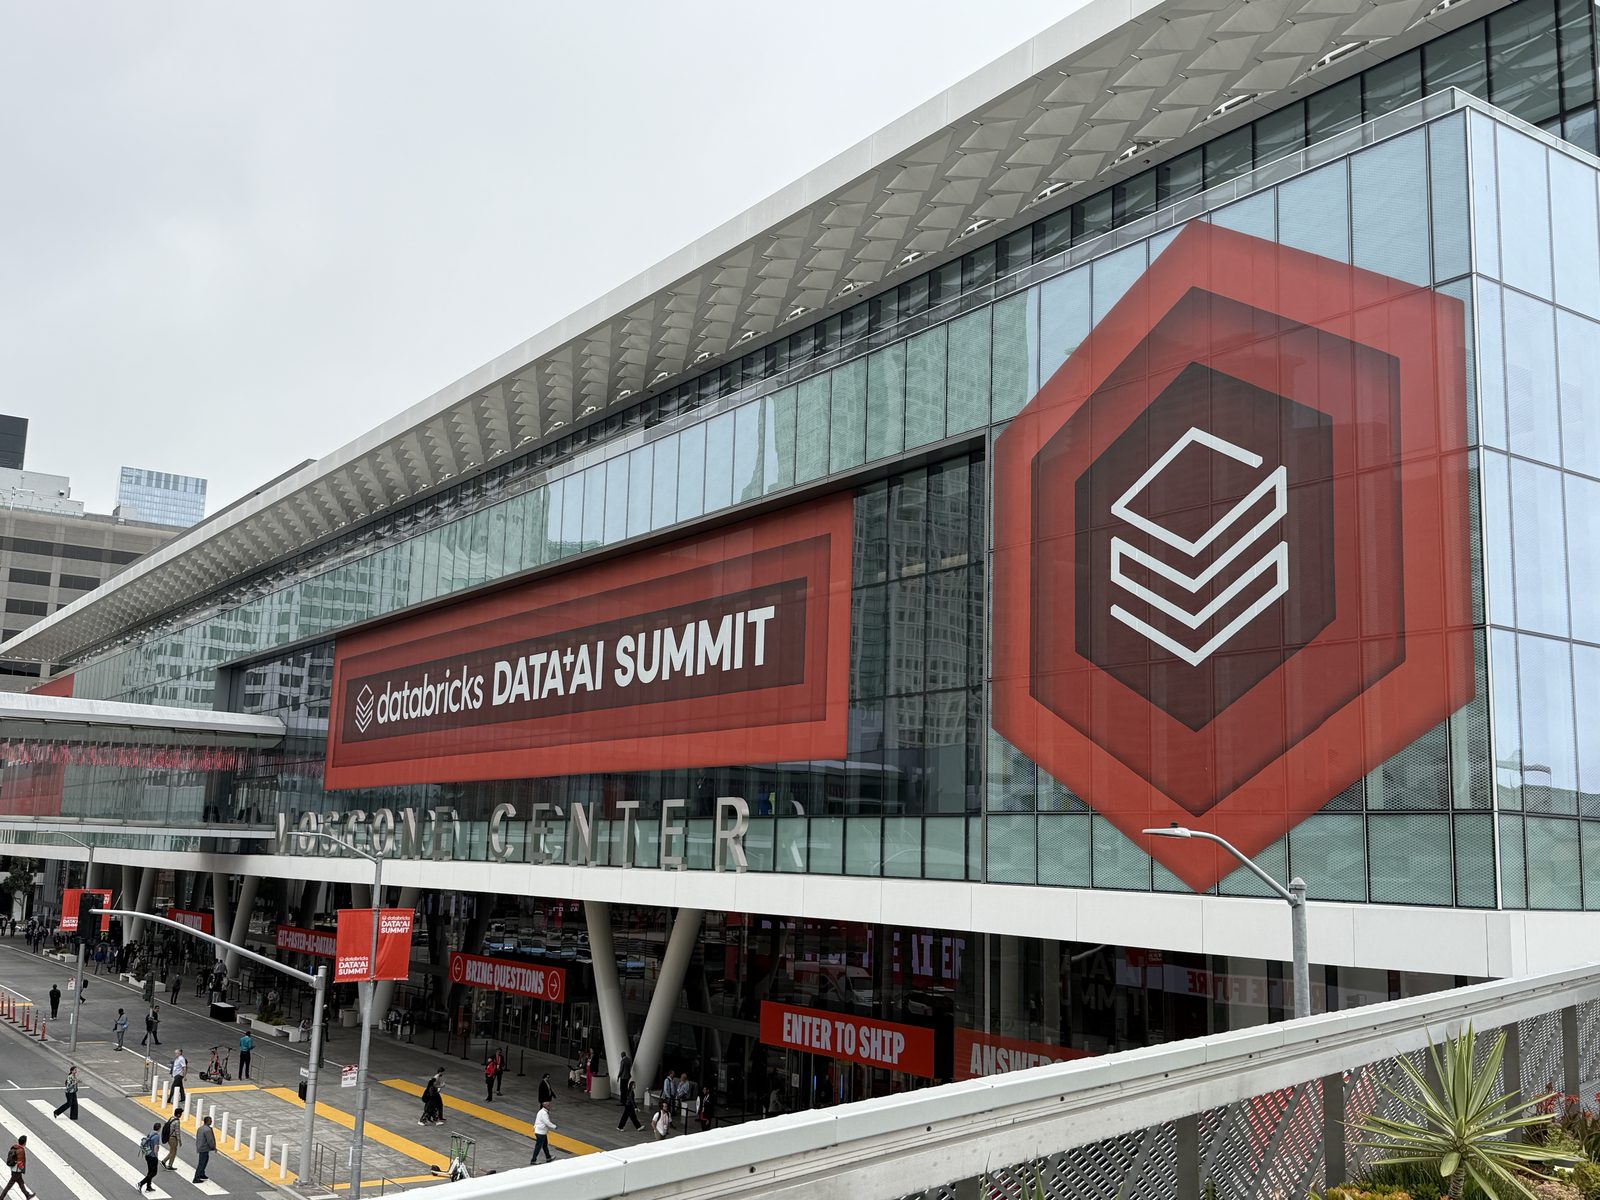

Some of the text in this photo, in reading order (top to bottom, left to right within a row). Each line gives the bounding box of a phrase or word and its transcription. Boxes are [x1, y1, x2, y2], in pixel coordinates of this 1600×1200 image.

[376, 605, 775, 724] databricks DATA+AI SUMMIT
[489, 797, 750, 873] CENTER
[338, 967, 368, 975] SUMMIT
[465, 959, 545, 994] BRING QUESTIONS
[783, 1012, 905, 1065] ENTER TO SHIP
